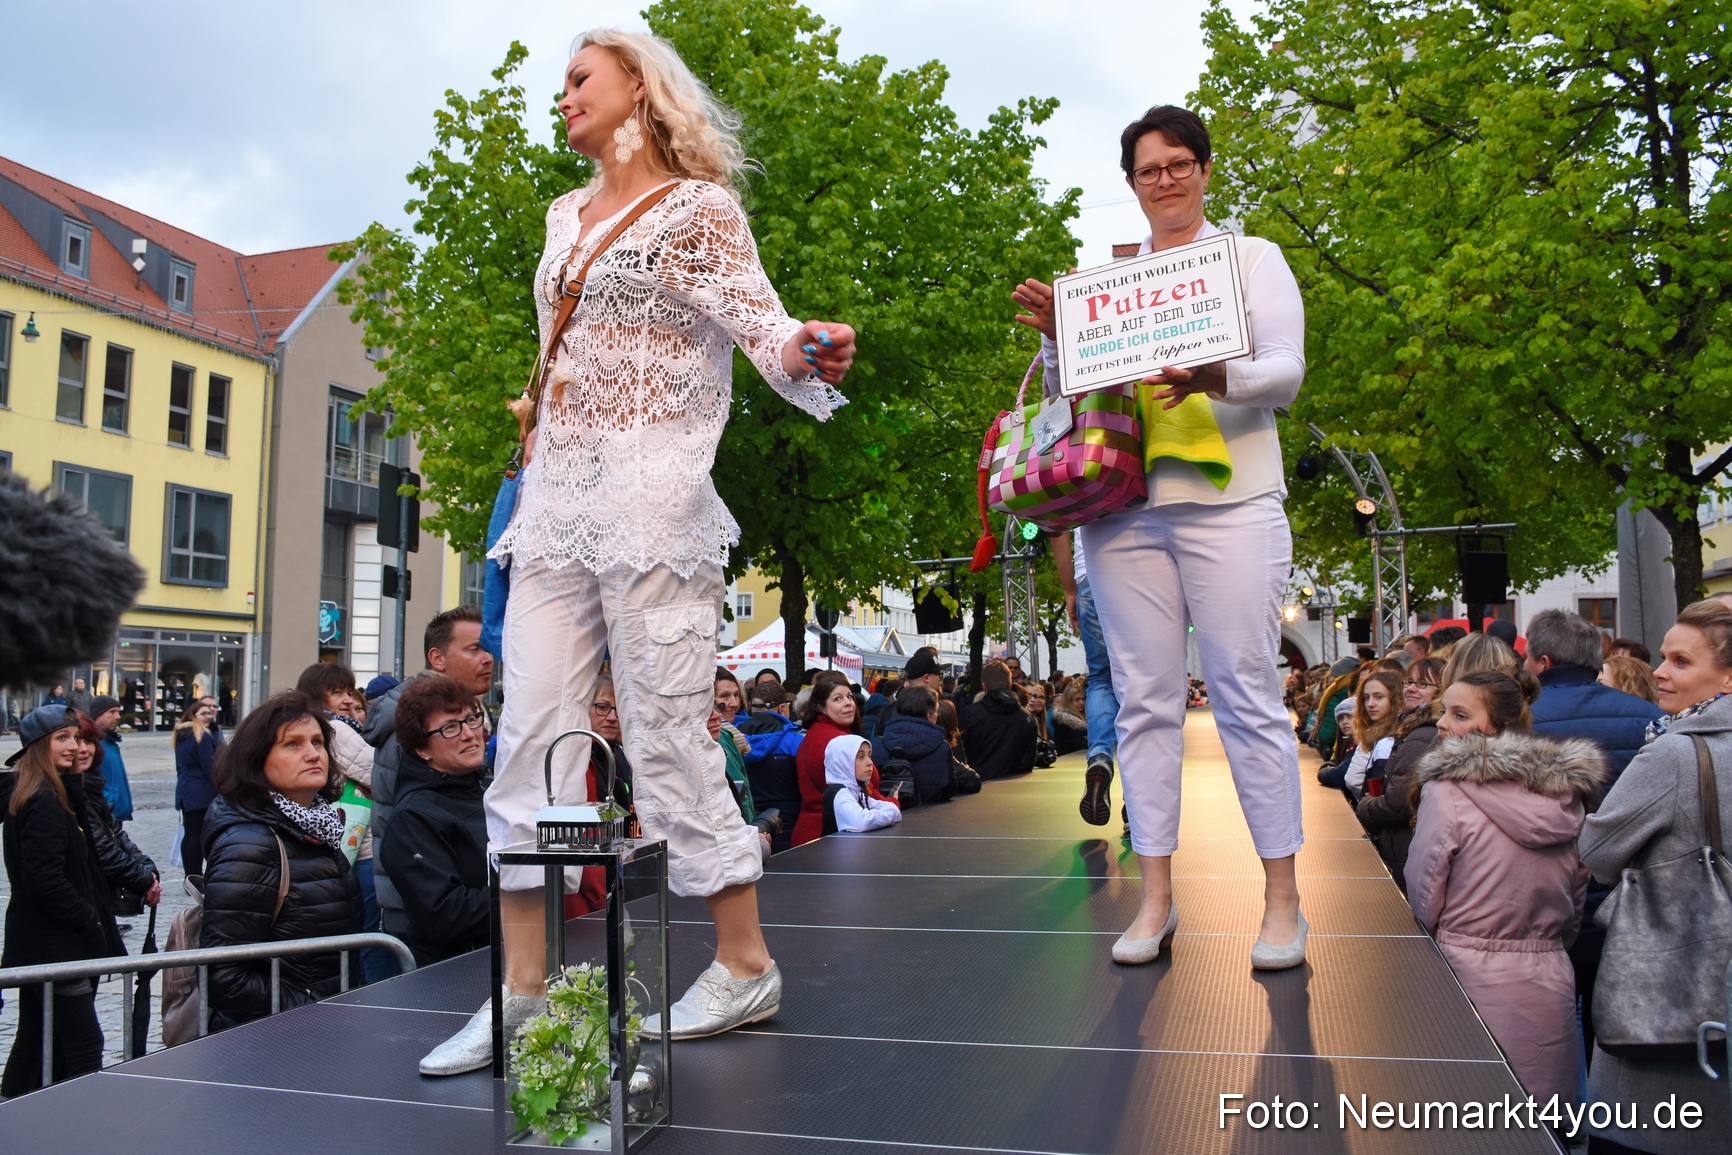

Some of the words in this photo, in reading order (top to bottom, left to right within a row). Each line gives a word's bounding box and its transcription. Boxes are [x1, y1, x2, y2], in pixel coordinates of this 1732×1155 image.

[1067, 272, 1142, 300] EIGENTLICH
[1145, 258, 1196, 280] WOLLTE
[1199, 252, 1222, 266] ICH
[1077, 324, 1113, 343] ABER
[1120, 316, 1146, 333] AUF
[1154, 307, 1185, 324] DEM
[1192, 298, 1222, 315] WEG
[1084, 278, 1209, 322] Putzen
[1075, 363, 1103, 376] JETZT
[1106, 359, 1120, 369] IST
[1123, 354, 1142, 365] DER
[1147, 341, 1202, 361] Lappen
[1207, 333, 1231, 345] WEG.
[1078, 339, 1125, 359] WURDE
[1128, 332, 1150, 348] ICH
[1153, 317, 1224, 341] GEBLITZT...
